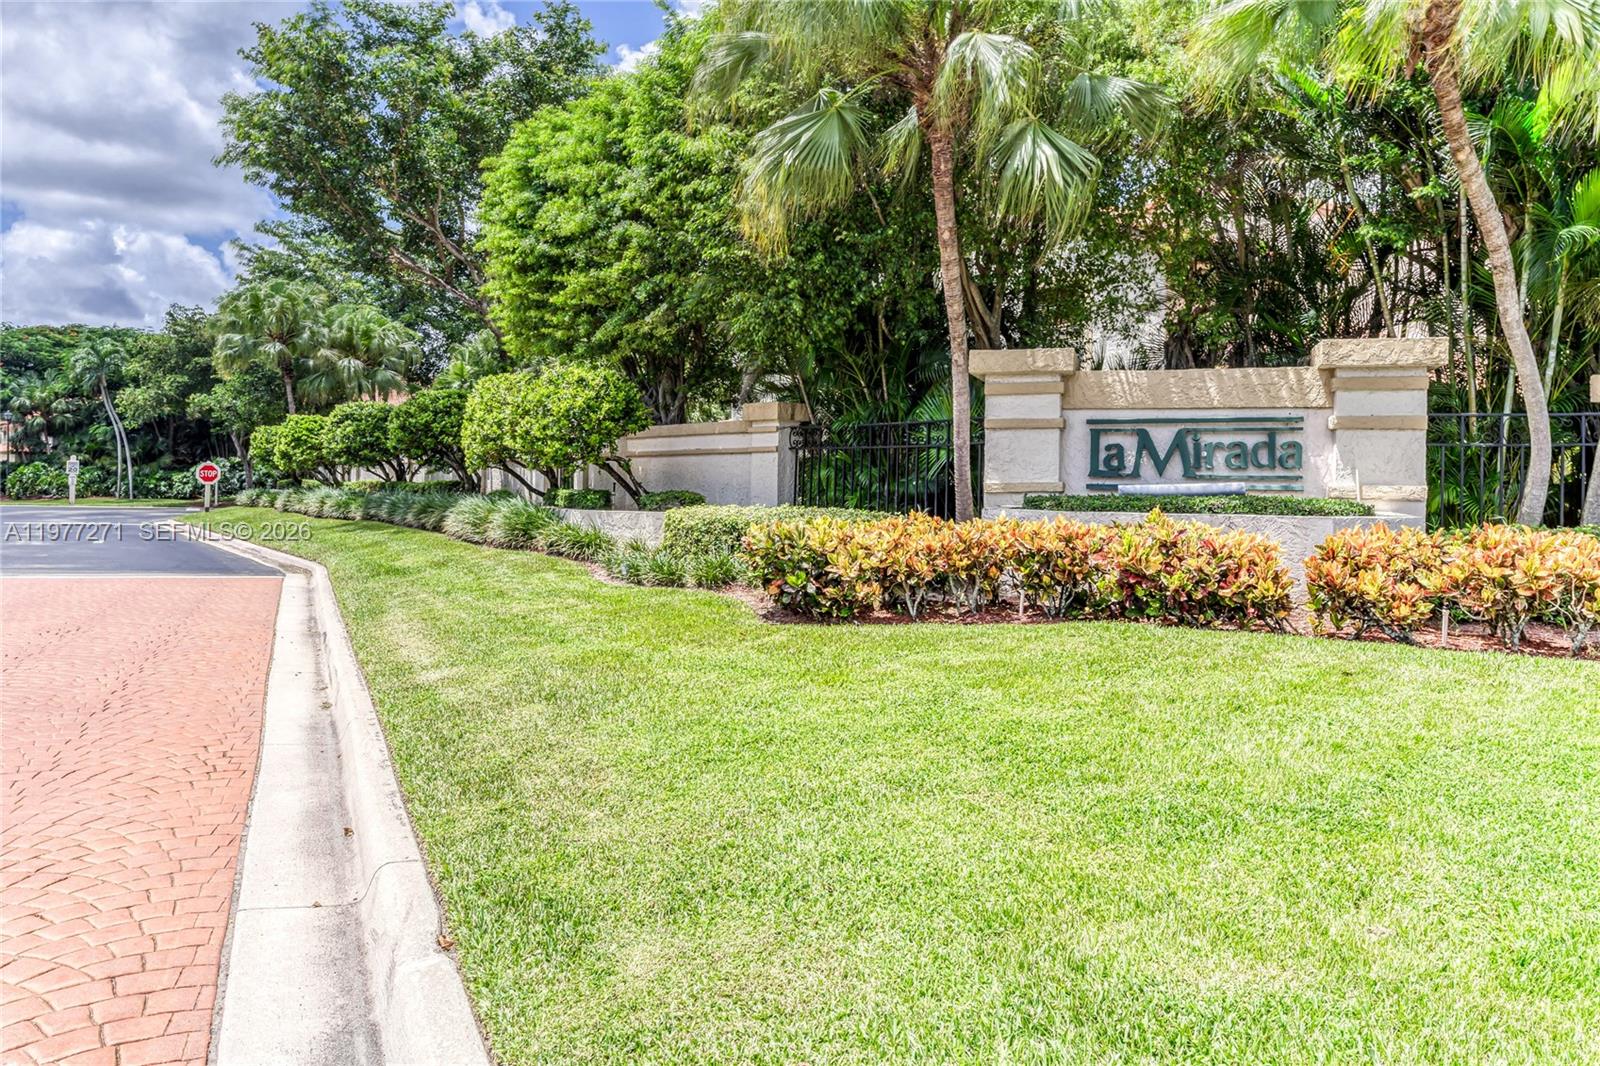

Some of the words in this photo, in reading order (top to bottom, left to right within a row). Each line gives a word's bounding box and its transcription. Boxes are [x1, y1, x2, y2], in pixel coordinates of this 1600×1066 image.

[1088, 428, 1127, 478] La
[1131, 428, 1303, 478] Mirada
[200, 470, 217, 478] STOP
